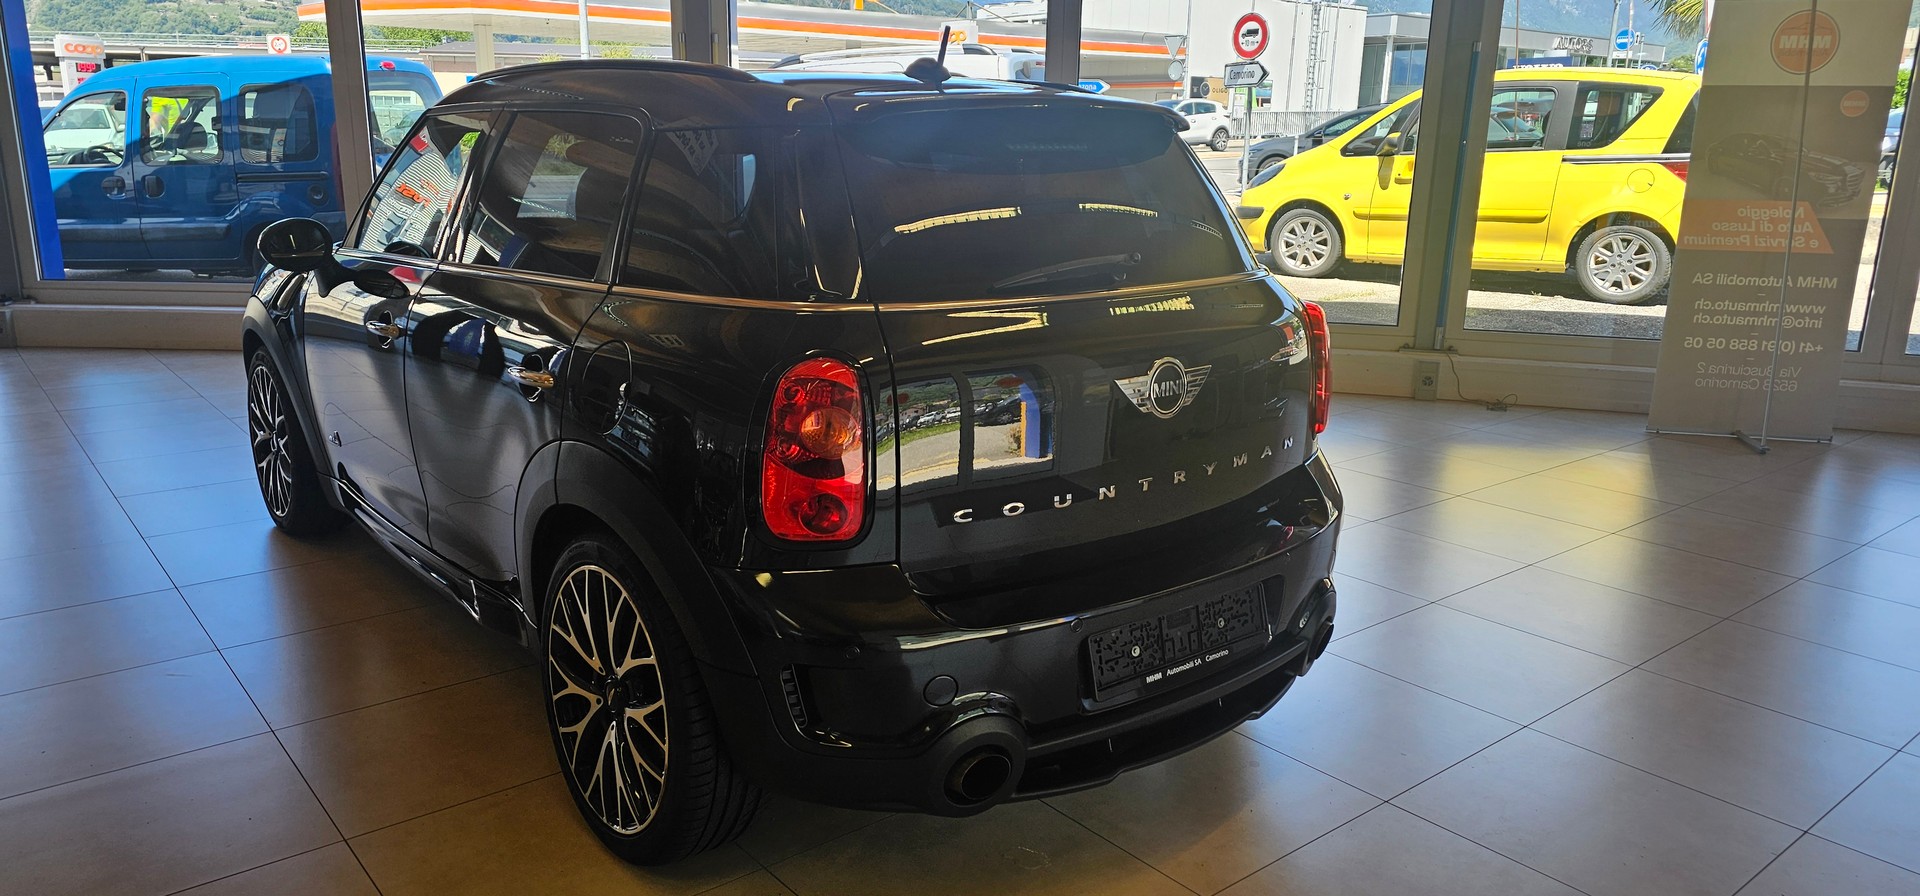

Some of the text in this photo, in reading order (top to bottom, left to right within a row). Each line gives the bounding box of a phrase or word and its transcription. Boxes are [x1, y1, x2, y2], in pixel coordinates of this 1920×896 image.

[1229, 68, 1256, 80] Camorino
[1154, 380, 1184, 398] MINI
[953, 437, 1294, 523] COUNTRYMAN
[1146, 649, 1229, 683] MHM Automobili SA Camorino
